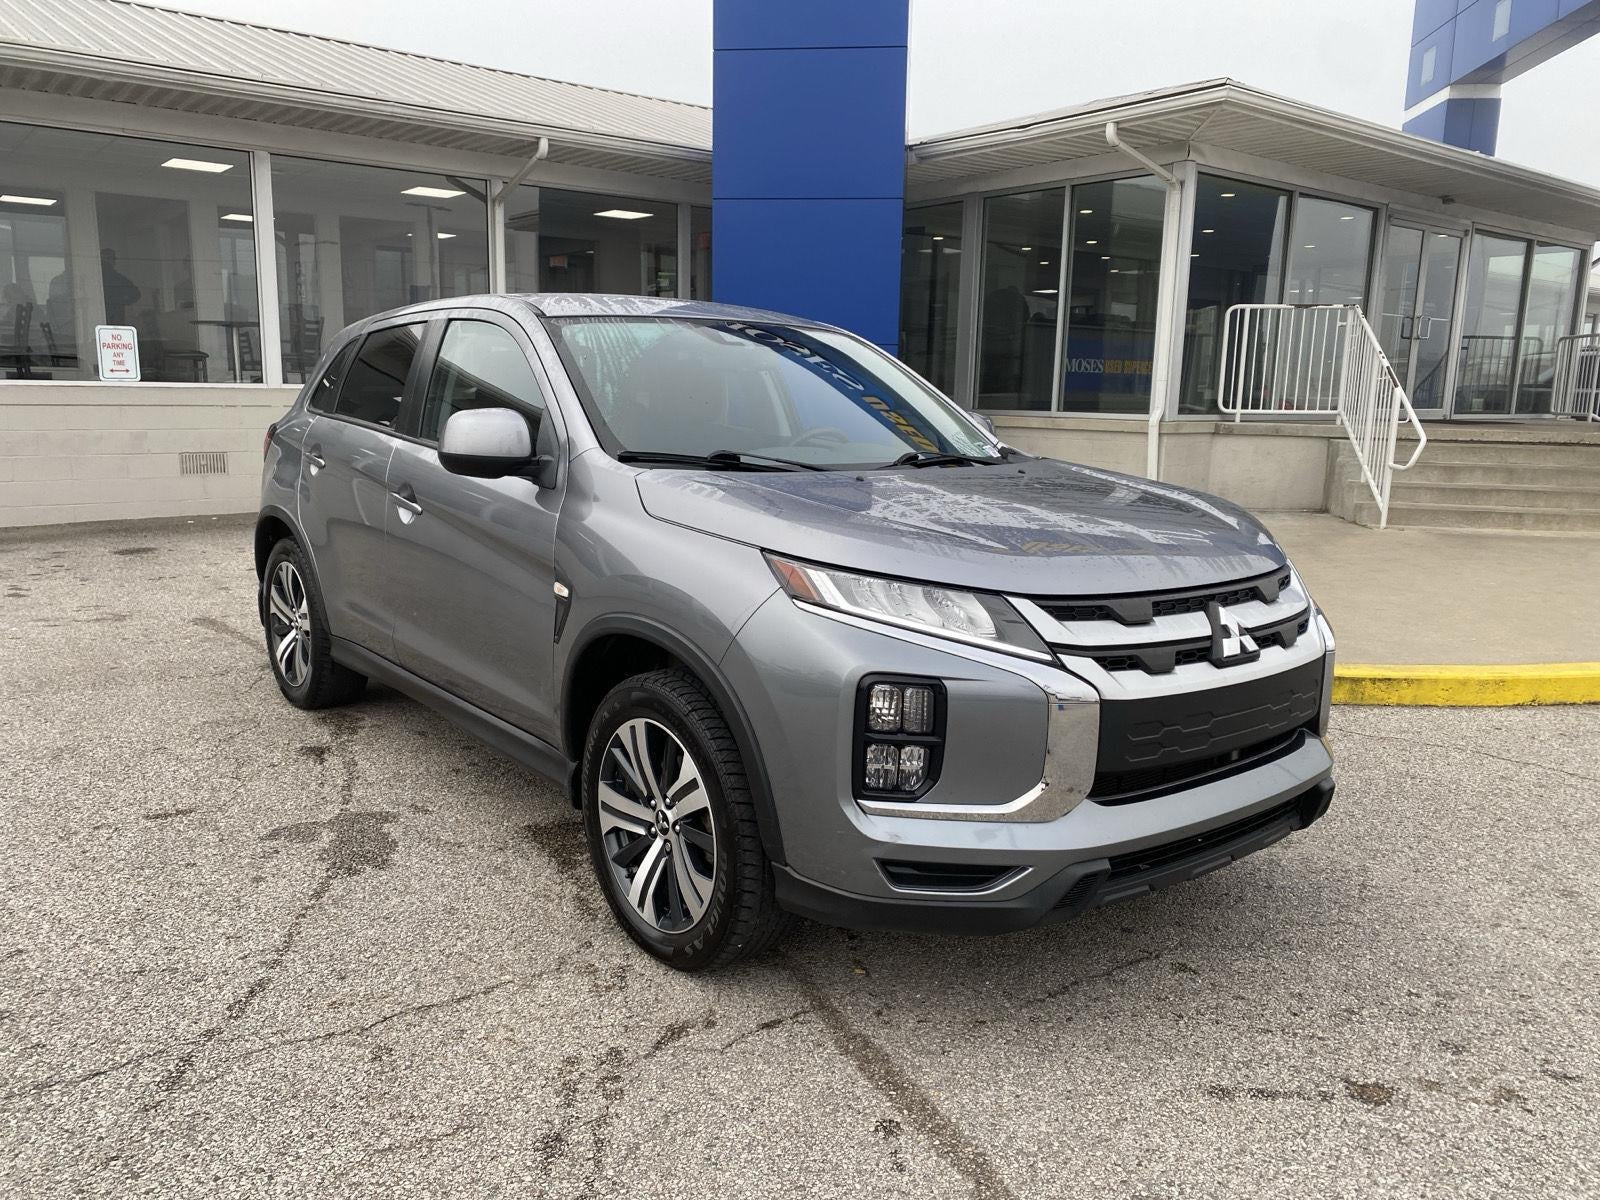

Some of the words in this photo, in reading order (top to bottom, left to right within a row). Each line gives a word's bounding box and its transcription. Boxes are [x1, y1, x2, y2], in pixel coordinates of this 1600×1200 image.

[102, 342, 133, 350] PARKING
[1065, 358, 1104, 373] MOSES
[685, 851, 727, 958] DOUGLAS
